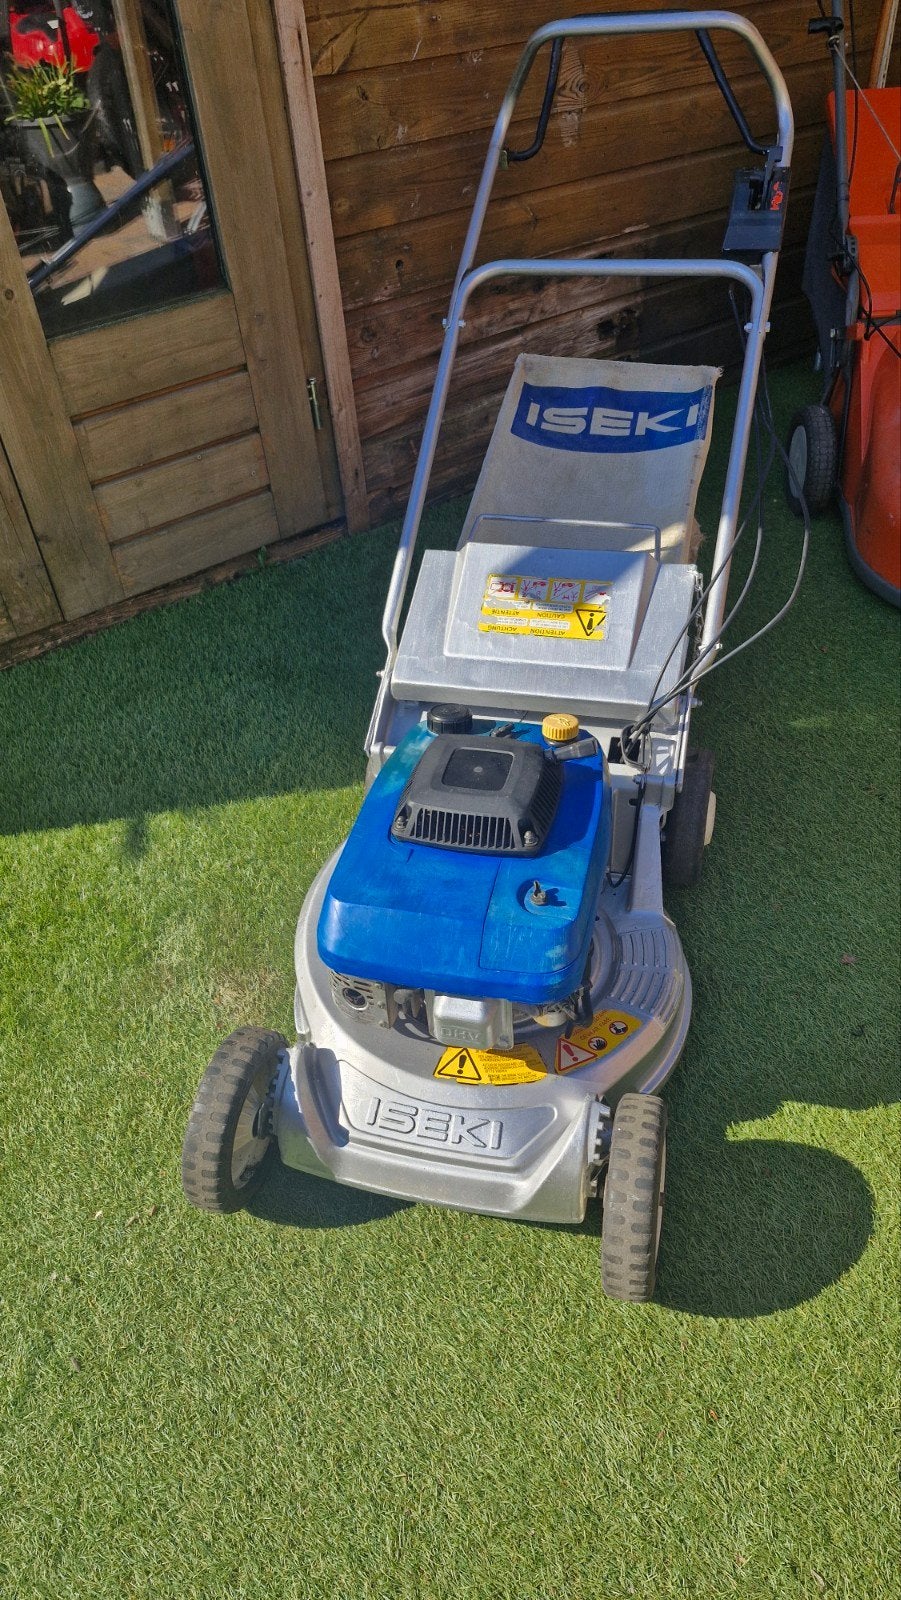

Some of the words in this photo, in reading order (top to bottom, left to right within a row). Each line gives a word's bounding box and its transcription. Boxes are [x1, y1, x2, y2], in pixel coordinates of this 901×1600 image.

[525, 402, 700, 436] ISEKI
[487, 624, 518, 632] ACHTUNG
[529, 628, 566, 636] ATTENTION
[366, 1097, 504, 1150] ISEKI
